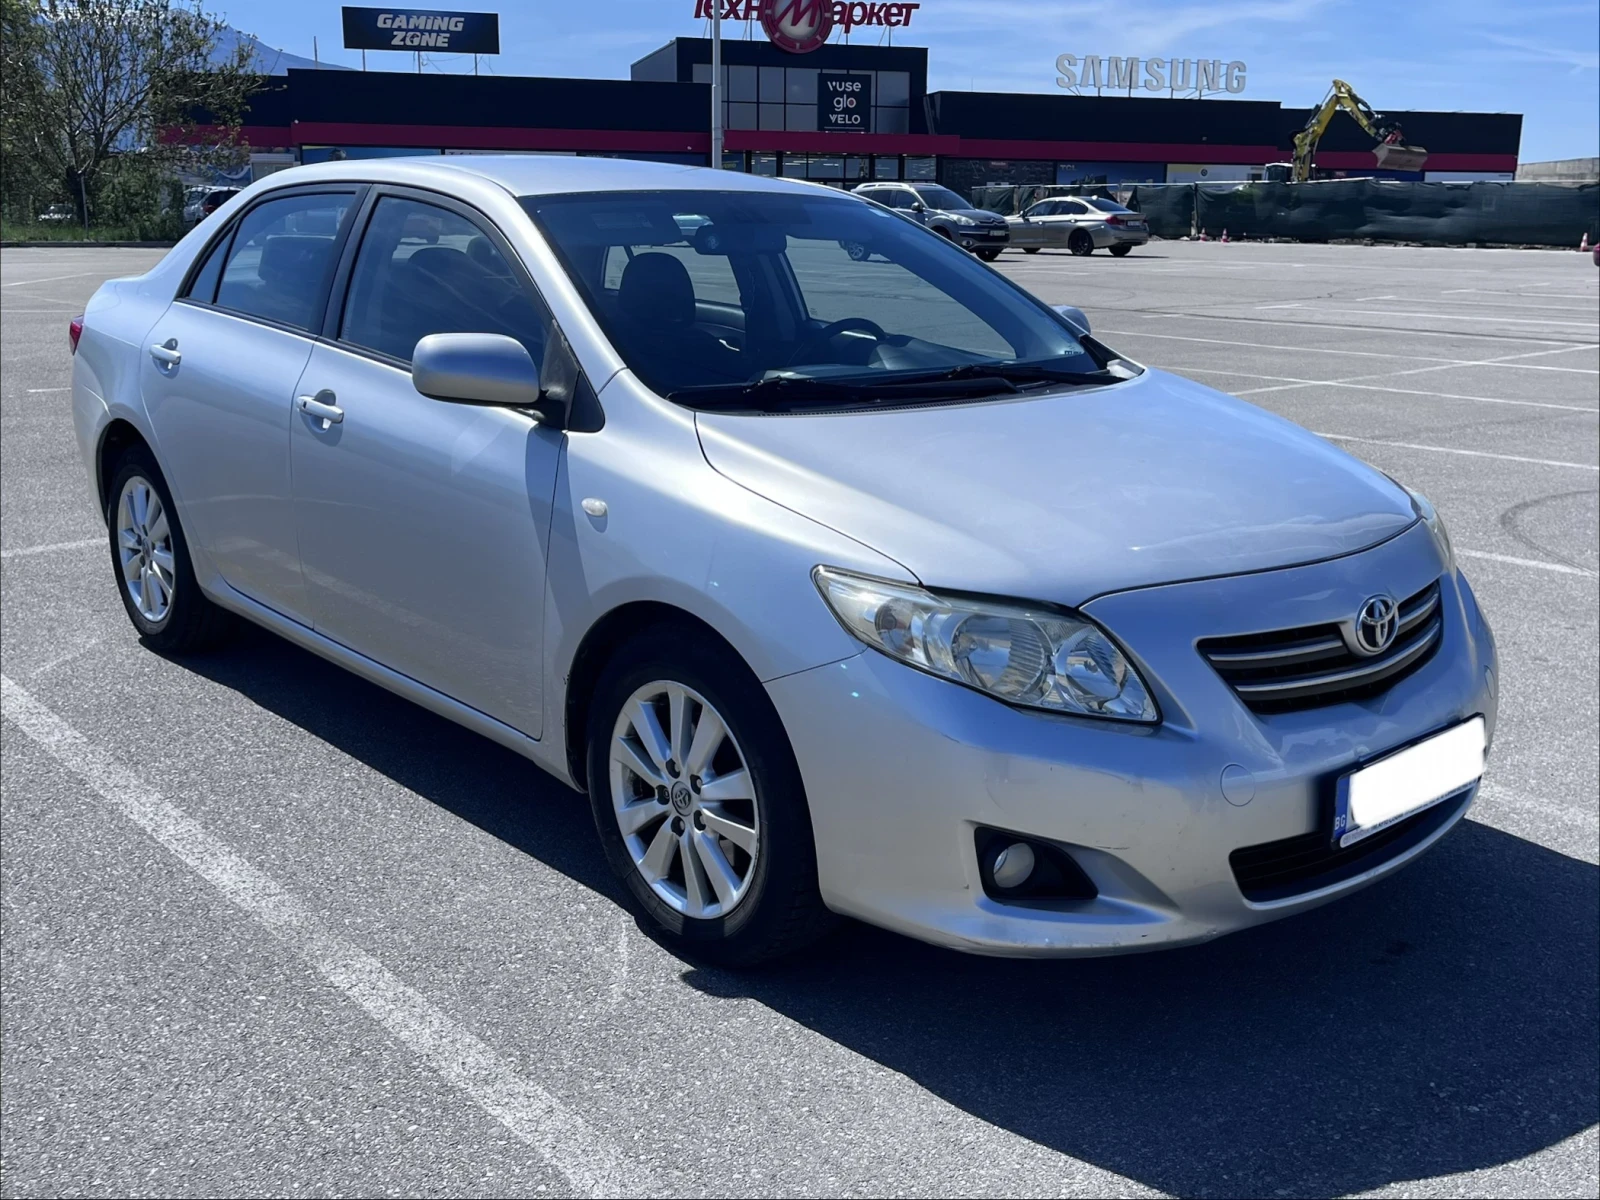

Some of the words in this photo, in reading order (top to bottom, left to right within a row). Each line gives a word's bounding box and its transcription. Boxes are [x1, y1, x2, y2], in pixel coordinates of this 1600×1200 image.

[377, 13, 464, 31] GAMING
[391, 31, 450, 47] ZONE
[1055, 53, 1247, 94] SAMSUNG
[833, 94, 857, 112] glo
[829, 114, 861, 125] VELO
[1335, 814, 1346, 831] BG
